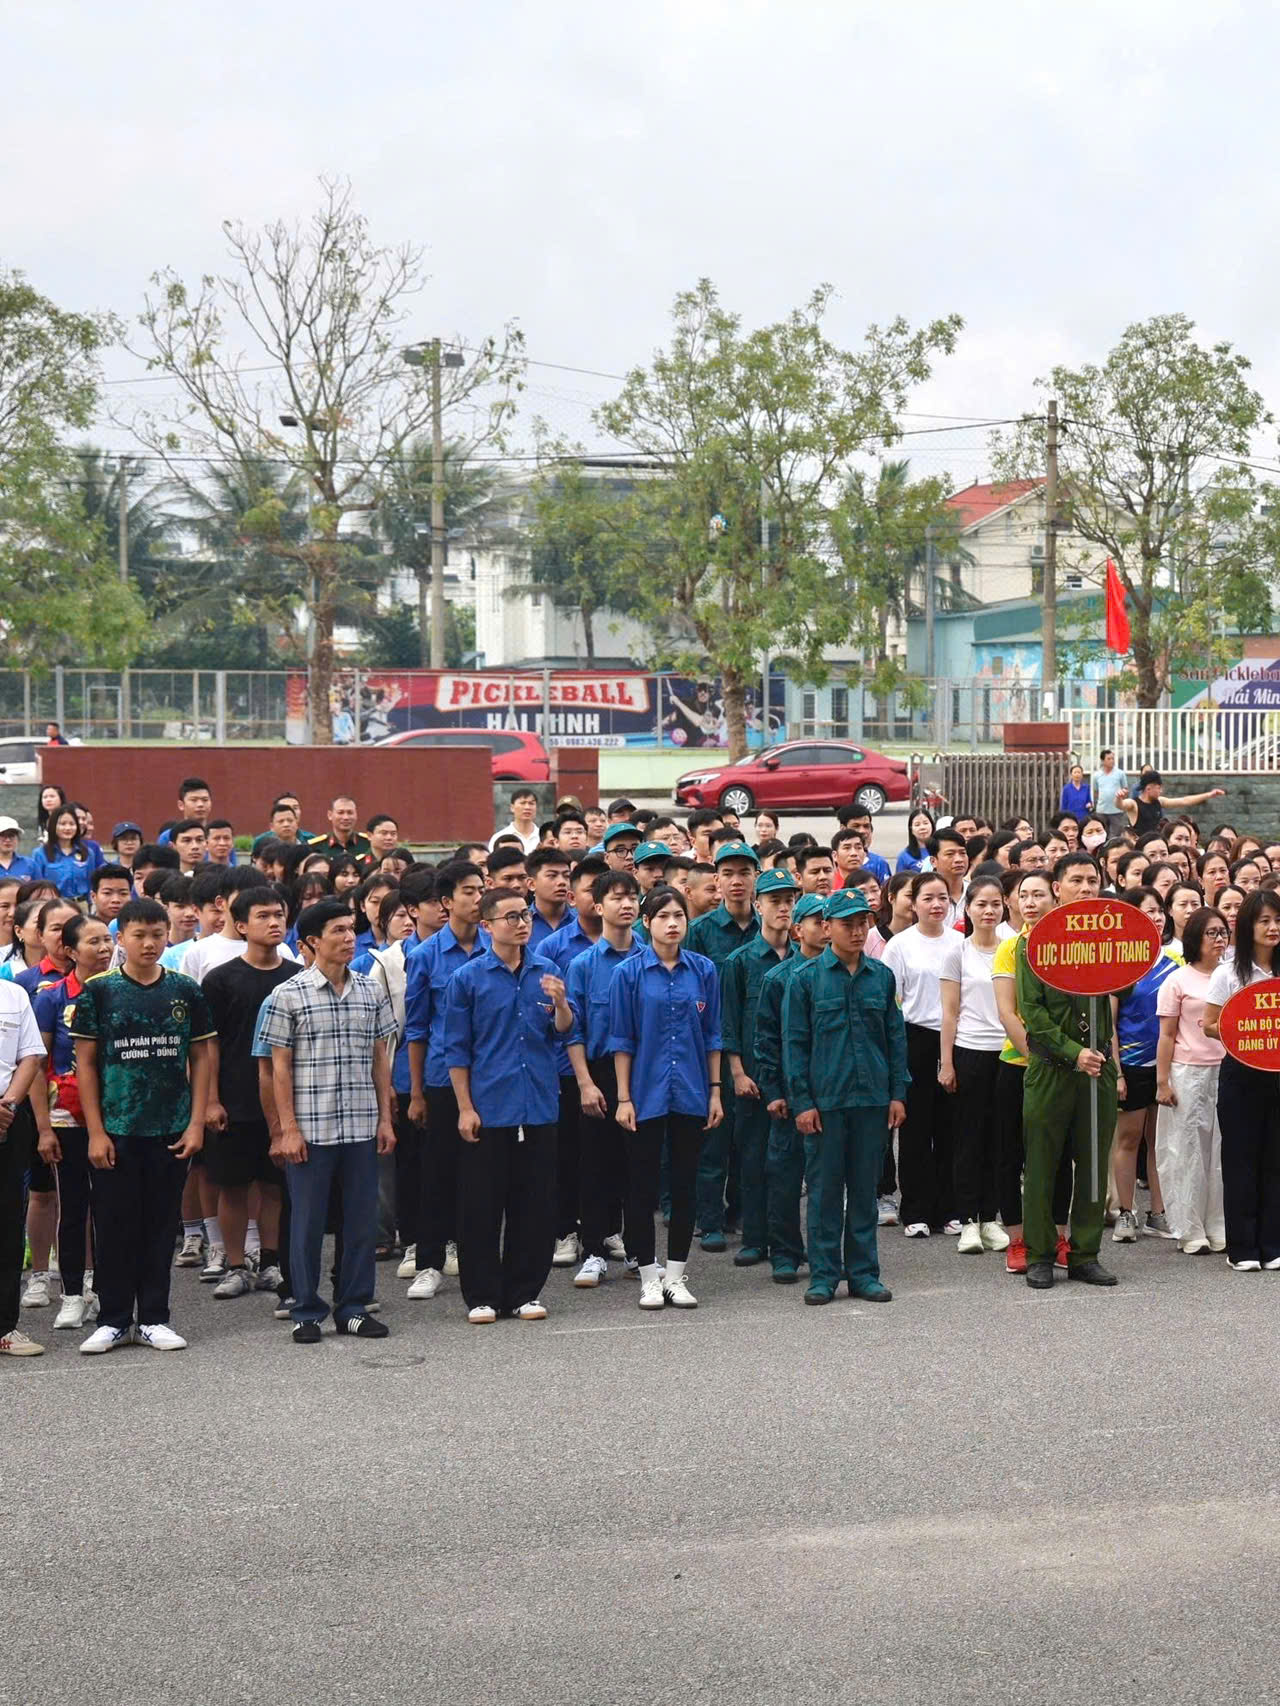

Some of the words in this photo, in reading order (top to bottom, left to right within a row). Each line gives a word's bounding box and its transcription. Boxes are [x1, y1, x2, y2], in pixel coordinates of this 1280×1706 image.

[450, 680, 634, 706] PICKLEBALL
[1065, 904, 1123, 931] KHỐI
[1037, 941, 1057, 971] LỰC
[1060, 940, 1096, 970] LƯỢNG
[1099, 937, 1113, 964] VŨ
[1115, 940, 1150, 963] TRANG
[1238, 1017, 1257, 1031] CÁN
[1259, 1016, 1272, 1033] BỘ
